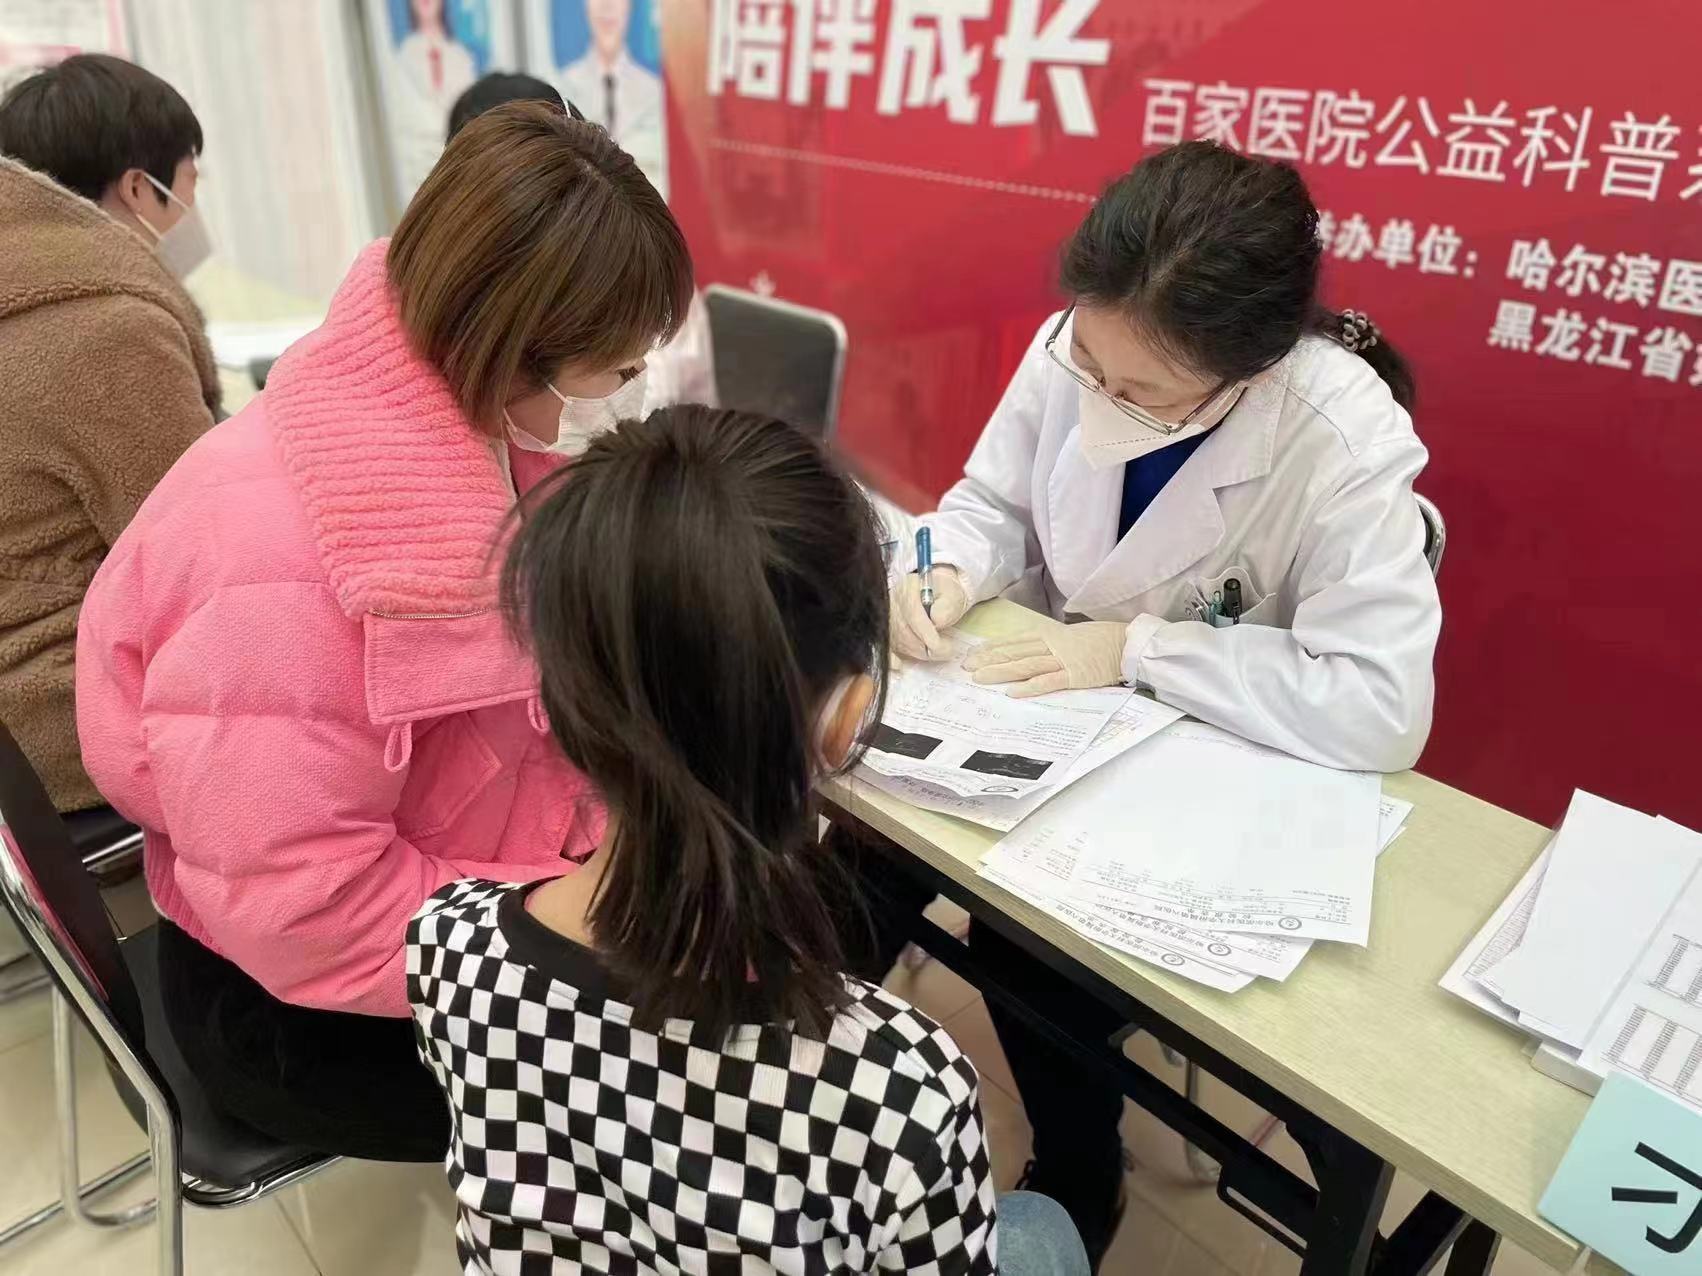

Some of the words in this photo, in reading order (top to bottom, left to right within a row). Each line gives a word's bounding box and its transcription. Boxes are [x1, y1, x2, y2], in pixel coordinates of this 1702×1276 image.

[706, 0, 1110, 137] 陪伴成长
[1142, 77, 1702, 201] 百家医院公益科普
[1486, 299, 1702, 387] 黑龙江省
